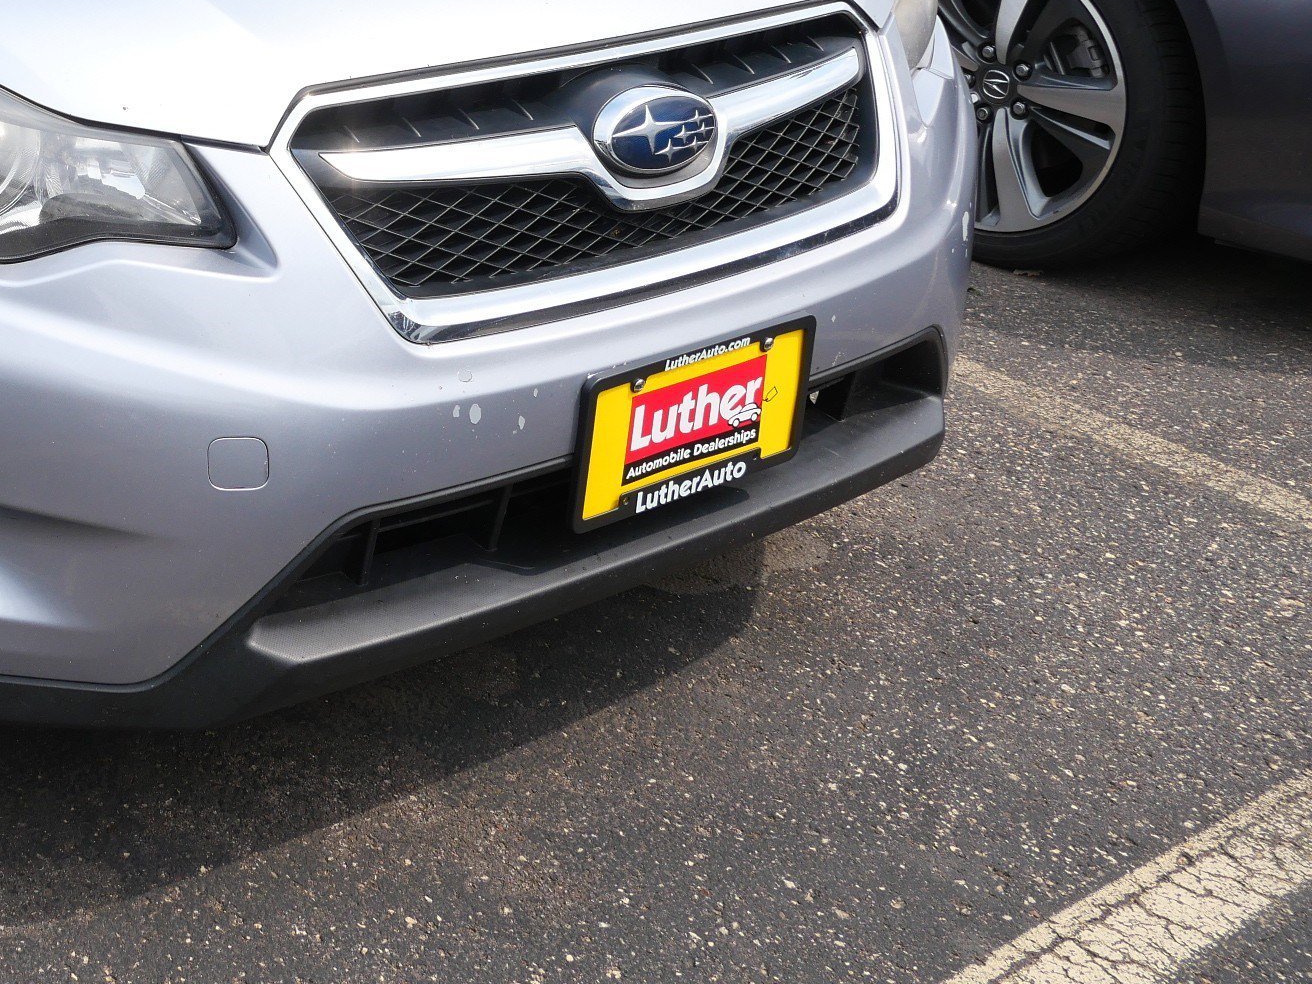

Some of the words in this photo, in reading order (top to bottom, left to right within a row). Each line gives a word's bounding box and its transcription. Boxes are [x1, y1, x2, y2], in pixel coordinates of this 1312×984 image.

[664, 336, 751, 372] LutherAuto.com
[629, 376, 763, 452] Luther
[625, 447, 691, 480] Automobile
[693, 428, 757, 457] Dealerships
[635, 460, 747, 514] LutherAuto
